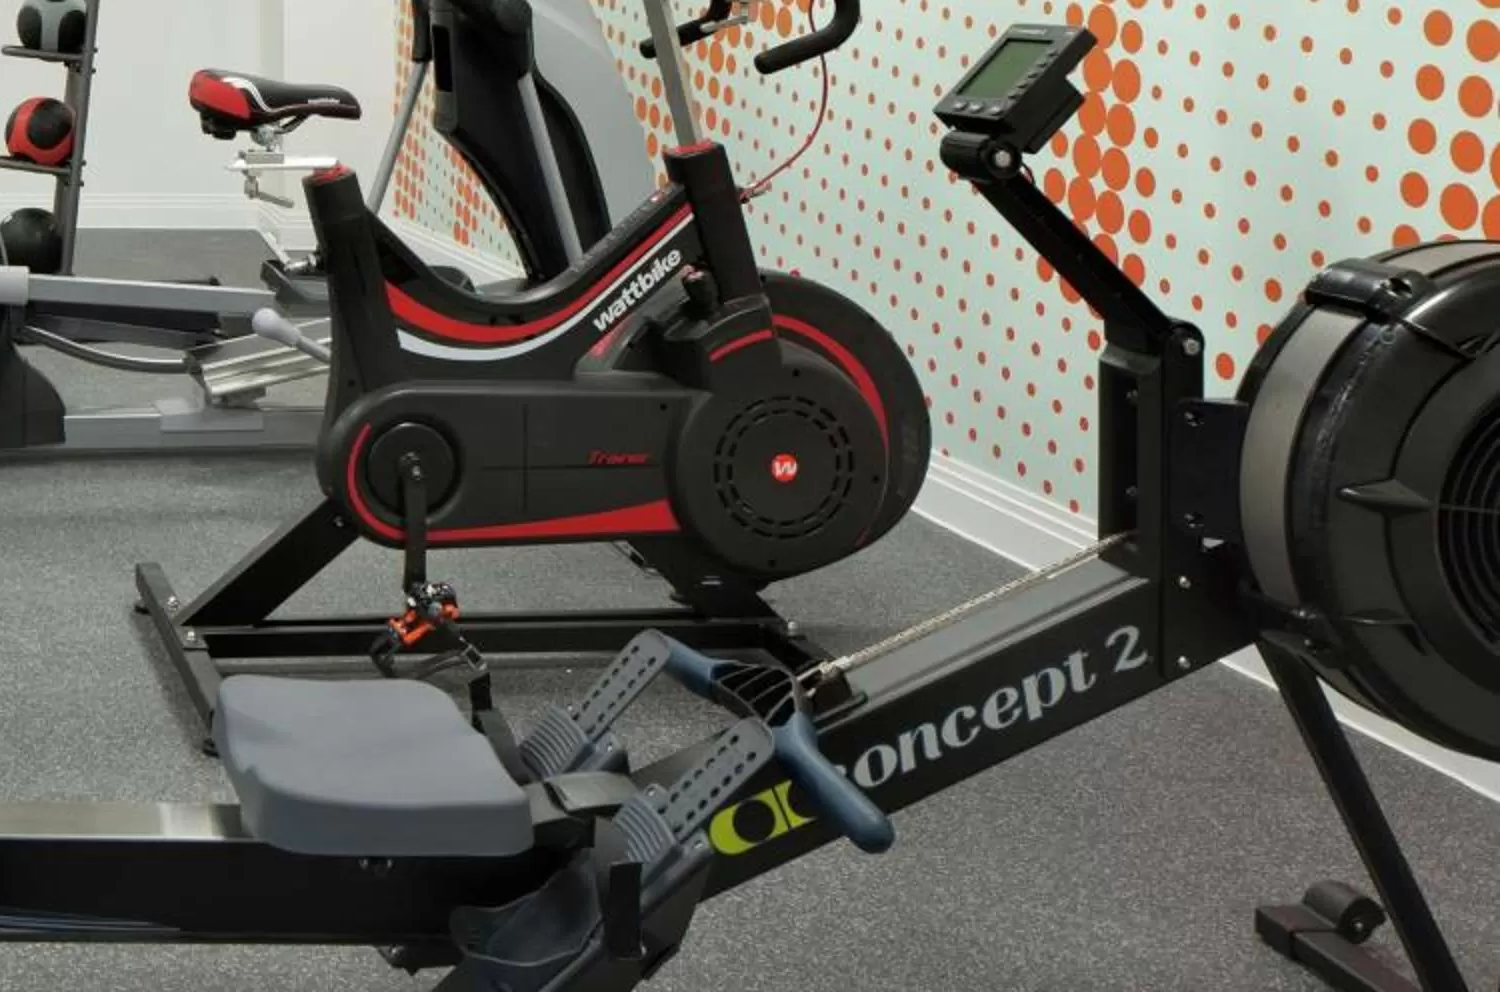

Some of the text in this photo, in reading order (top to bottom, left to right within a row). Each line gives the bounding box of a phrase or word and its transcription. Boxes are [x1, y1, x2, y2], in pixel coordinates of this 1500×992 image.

[593, 249, 681, 331] wattbike
[835, 625, 1149, 788] oncept 2
